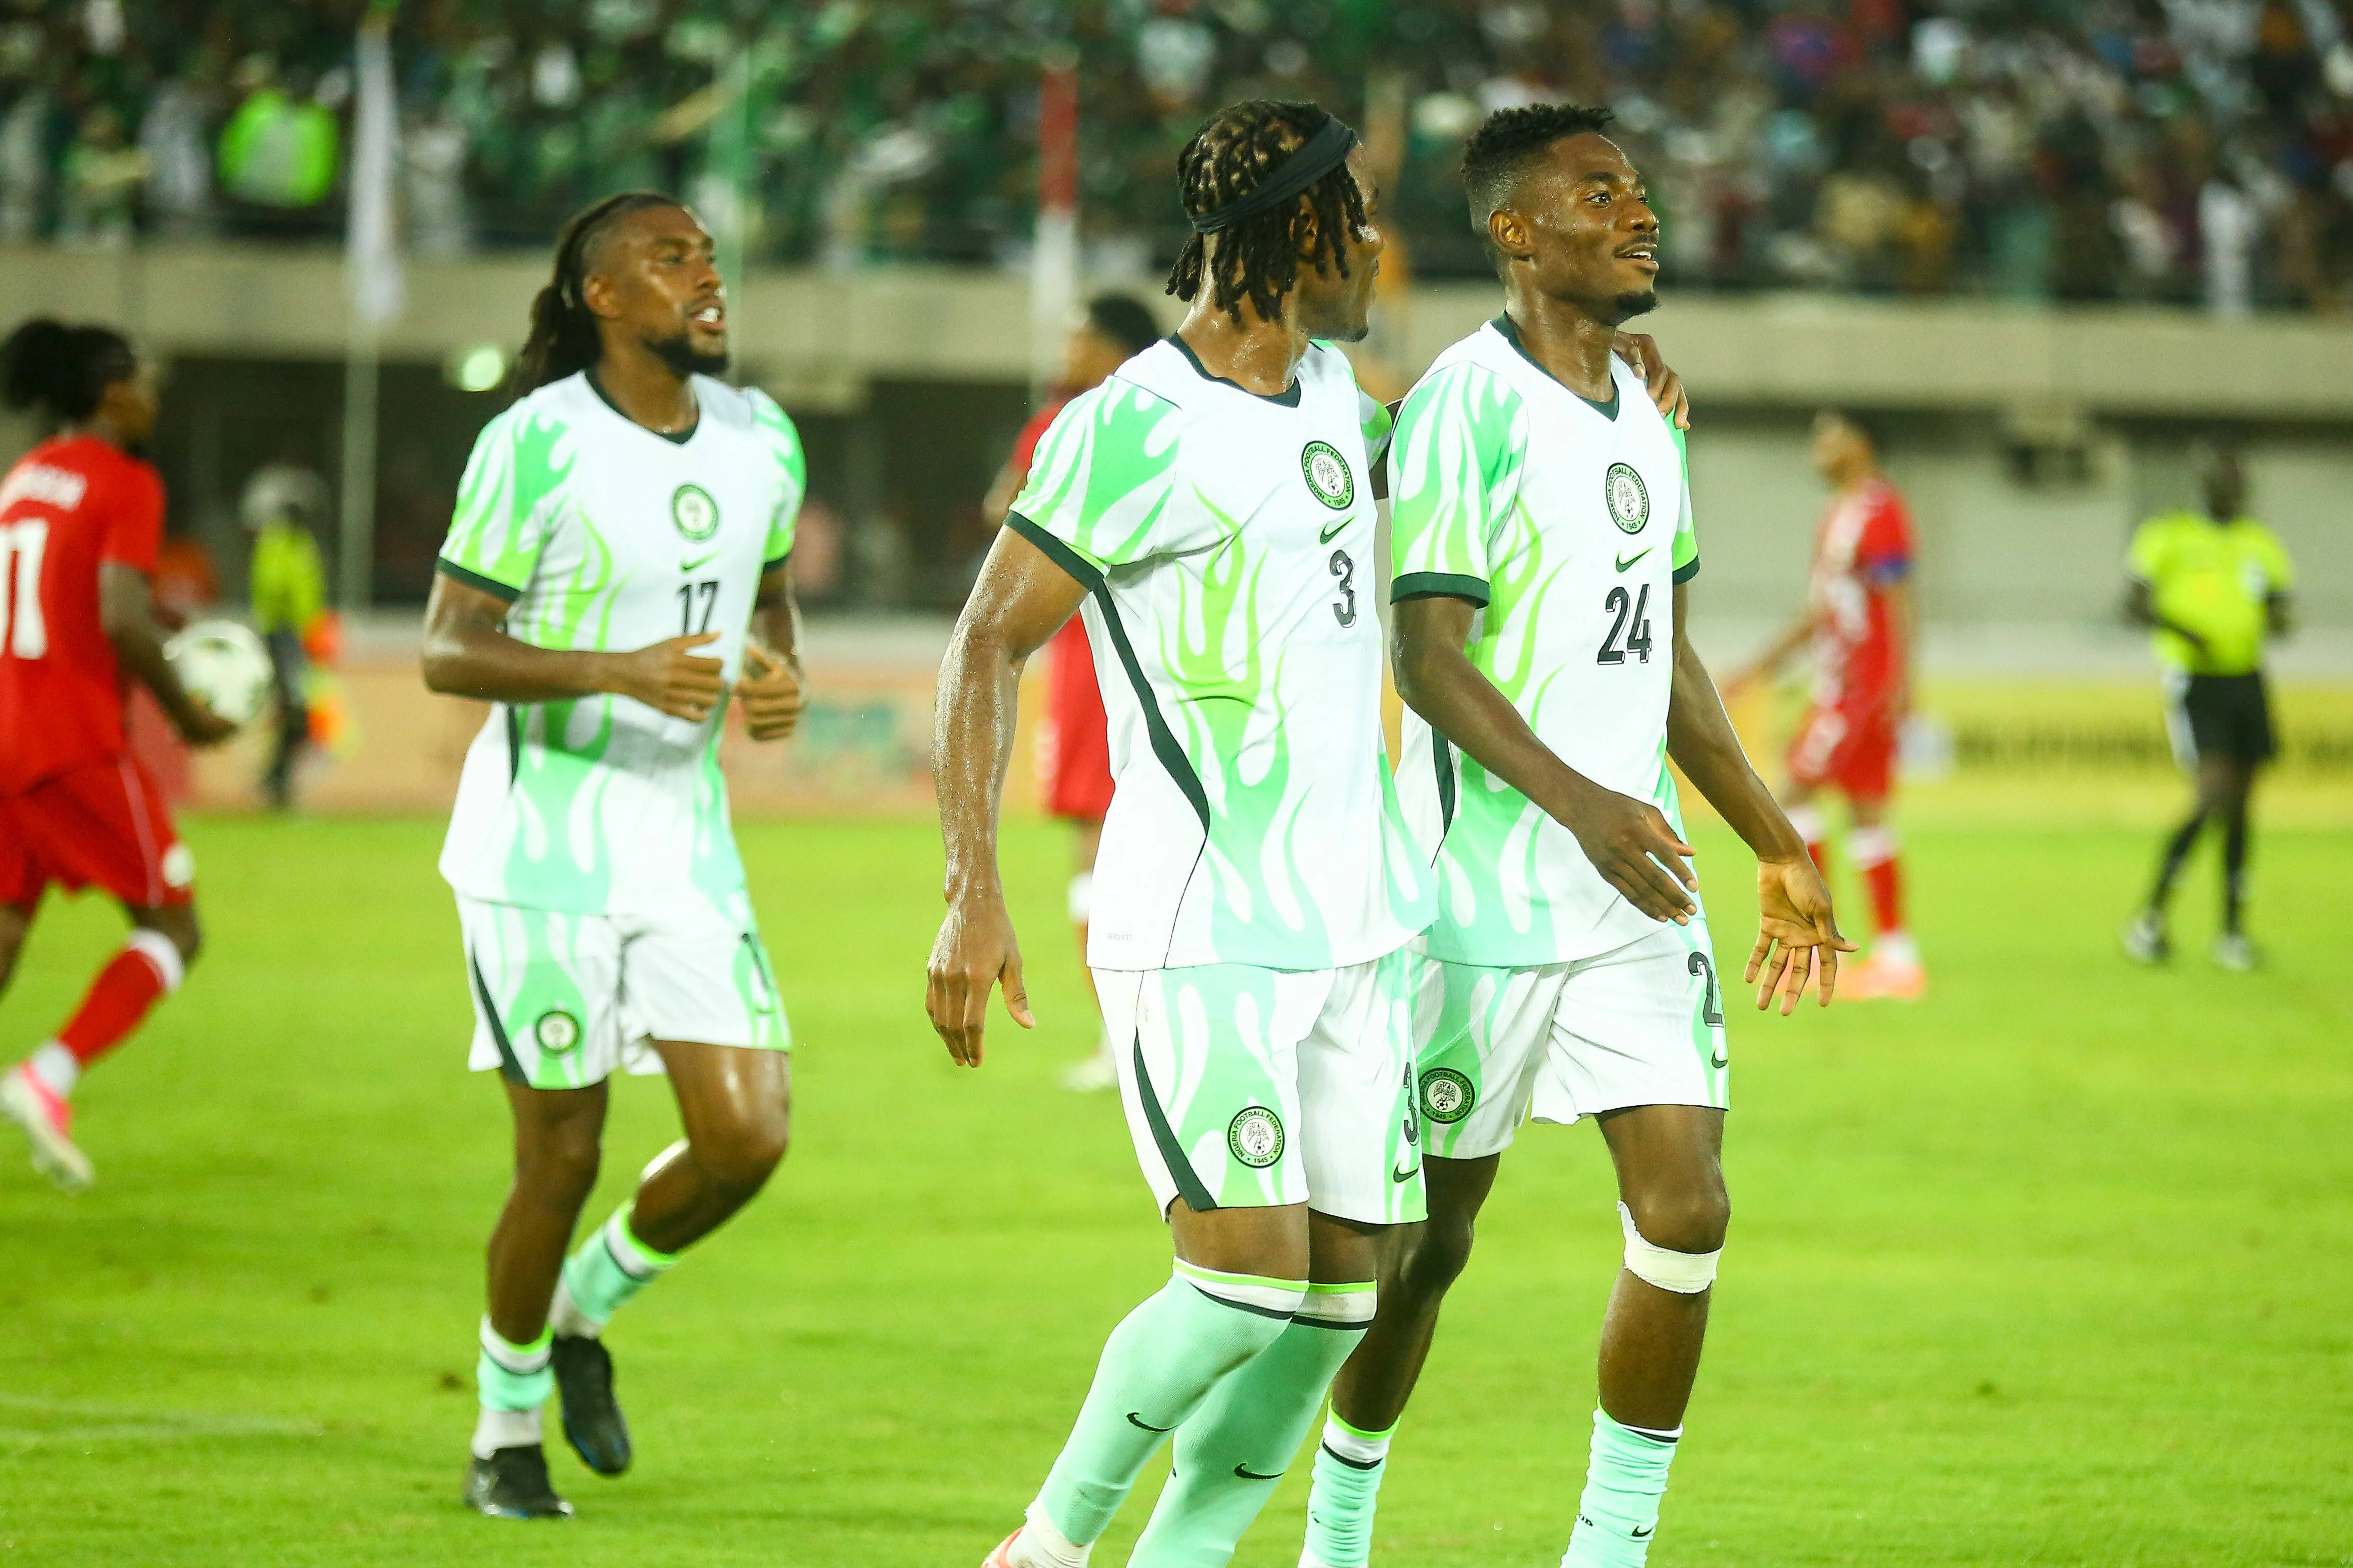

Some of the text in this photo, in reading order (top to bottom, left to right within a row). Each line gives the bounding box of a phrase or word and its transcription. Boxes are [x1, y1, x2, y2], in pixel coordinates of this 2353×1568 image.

[1304, 445, 1351, 500] NIGERIA FOOTBALL FEDERATION
[1608, 466, 1647, 522] NIGERIA FOOTBALL FEDERATION
[1333, 498, 1346, 506] 1945
[676, 580, 719, 635] 17
[1329, 549, 1357, 629] 3
[1597, 583, 1652, 665] 24
[1688, 951, 1724, 1028] 2
[1403, 1062, 1420, 1146] 3
[1427, 1071, 1460, 1083] FOOTBALL
[1455, 1079, 1471, 1117] FEDERATION
[1232, 1110, 1281, 1158] NIGERIA FOOTBALL FEDERATION
